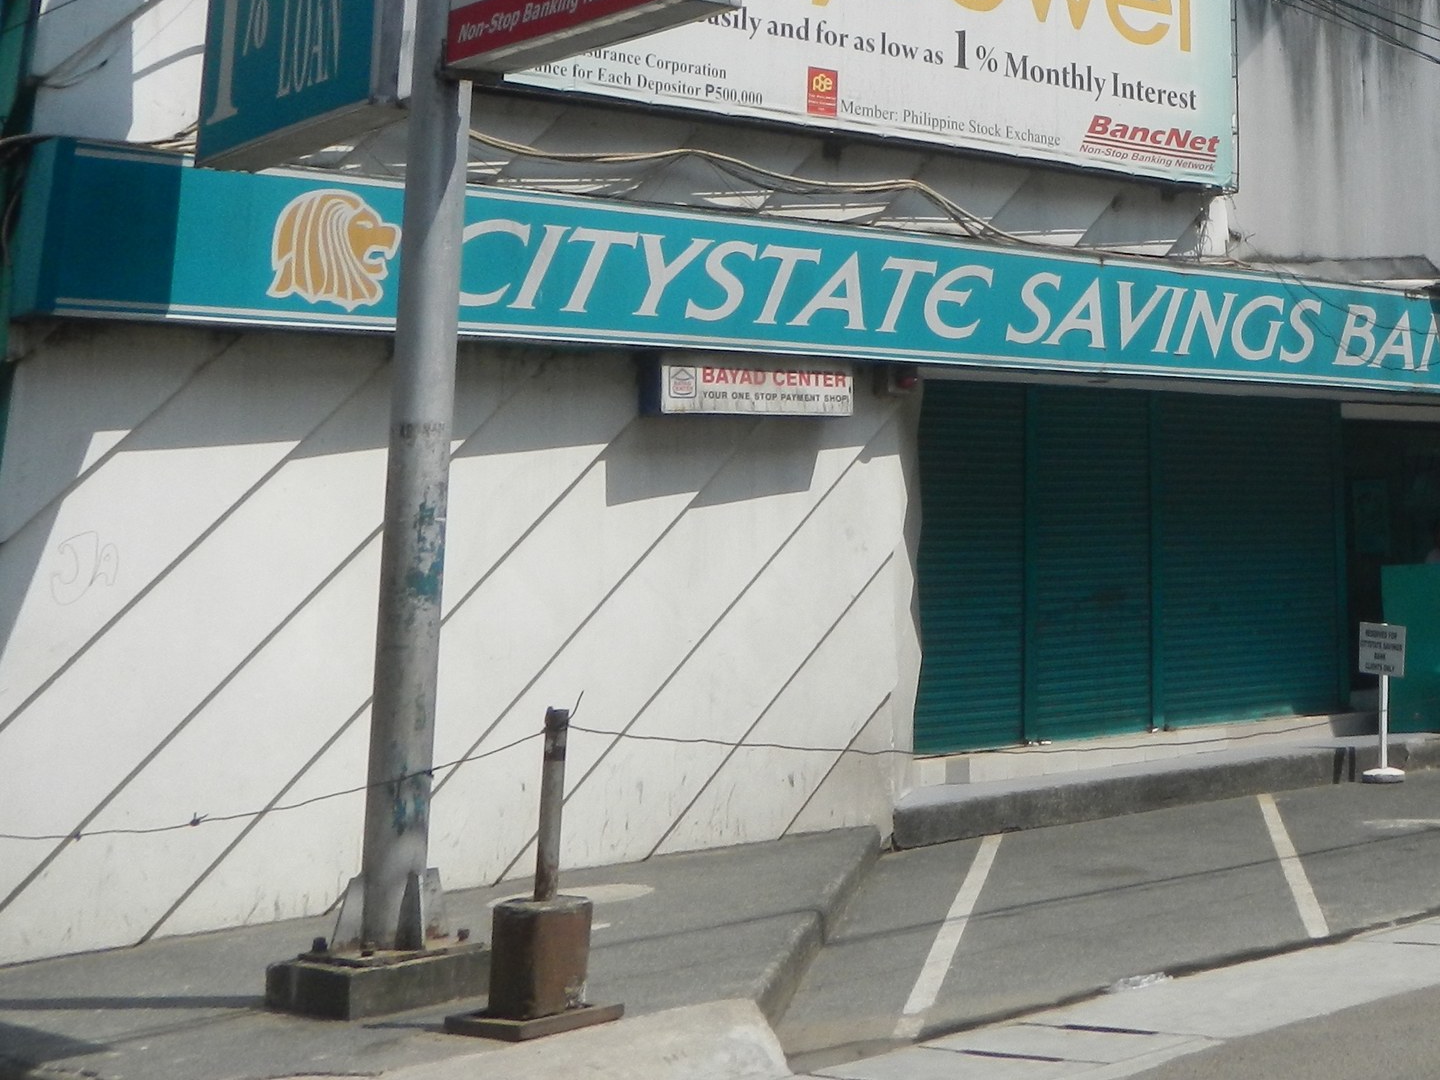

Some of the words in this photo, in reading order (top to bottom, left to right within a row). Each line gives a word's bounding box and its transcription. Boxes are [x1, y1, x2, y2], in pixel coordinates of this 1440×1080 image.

[458, 9, 520, 43] Non-Stop
[645, 53, 727, 81] Corporation
[698, 7, 761, 40] asily
[766, 18, 810, 42] and
[816, 19, 849, 48] for
[853, 35, 875, 55] as
[880, 32, 919, 60] low
[923, 47, 944, 66] as
[1004, 51, 1106, 101] Monthly
[1111, 72, 1197, 110] Interest
[572, 64, 593, 80] for
[598, 68, 632, 86] Each
[637, 74, 702, 97] Depositor
[840, 99, 898, 122] Member:
[902, 109, 965, 133] Philippine
[969, 120, 1001, 138] Stock
[1005, 126, 1061, 147] Exchange
[1087, 115, 1220, 152] BancNet
[1079, 144, 1129, 161] Non-Stop
[1131, 152, 1173, 168] Banking
[1174, 159, 1215, 172] Network
[459, 218, 994, 340] CITYSTATE
[1004, 272, 1322, 365] SAVINGS
[702, 367, 766, 386] BAYAD
[772, 371, 847, 388] CENTER
[702, 392, 728, 400] YOUR
[731, 392, 750, 400] ONE
[754, 393, 777, 401] STOP
[780, 394, 820, 402] PAYMENT
